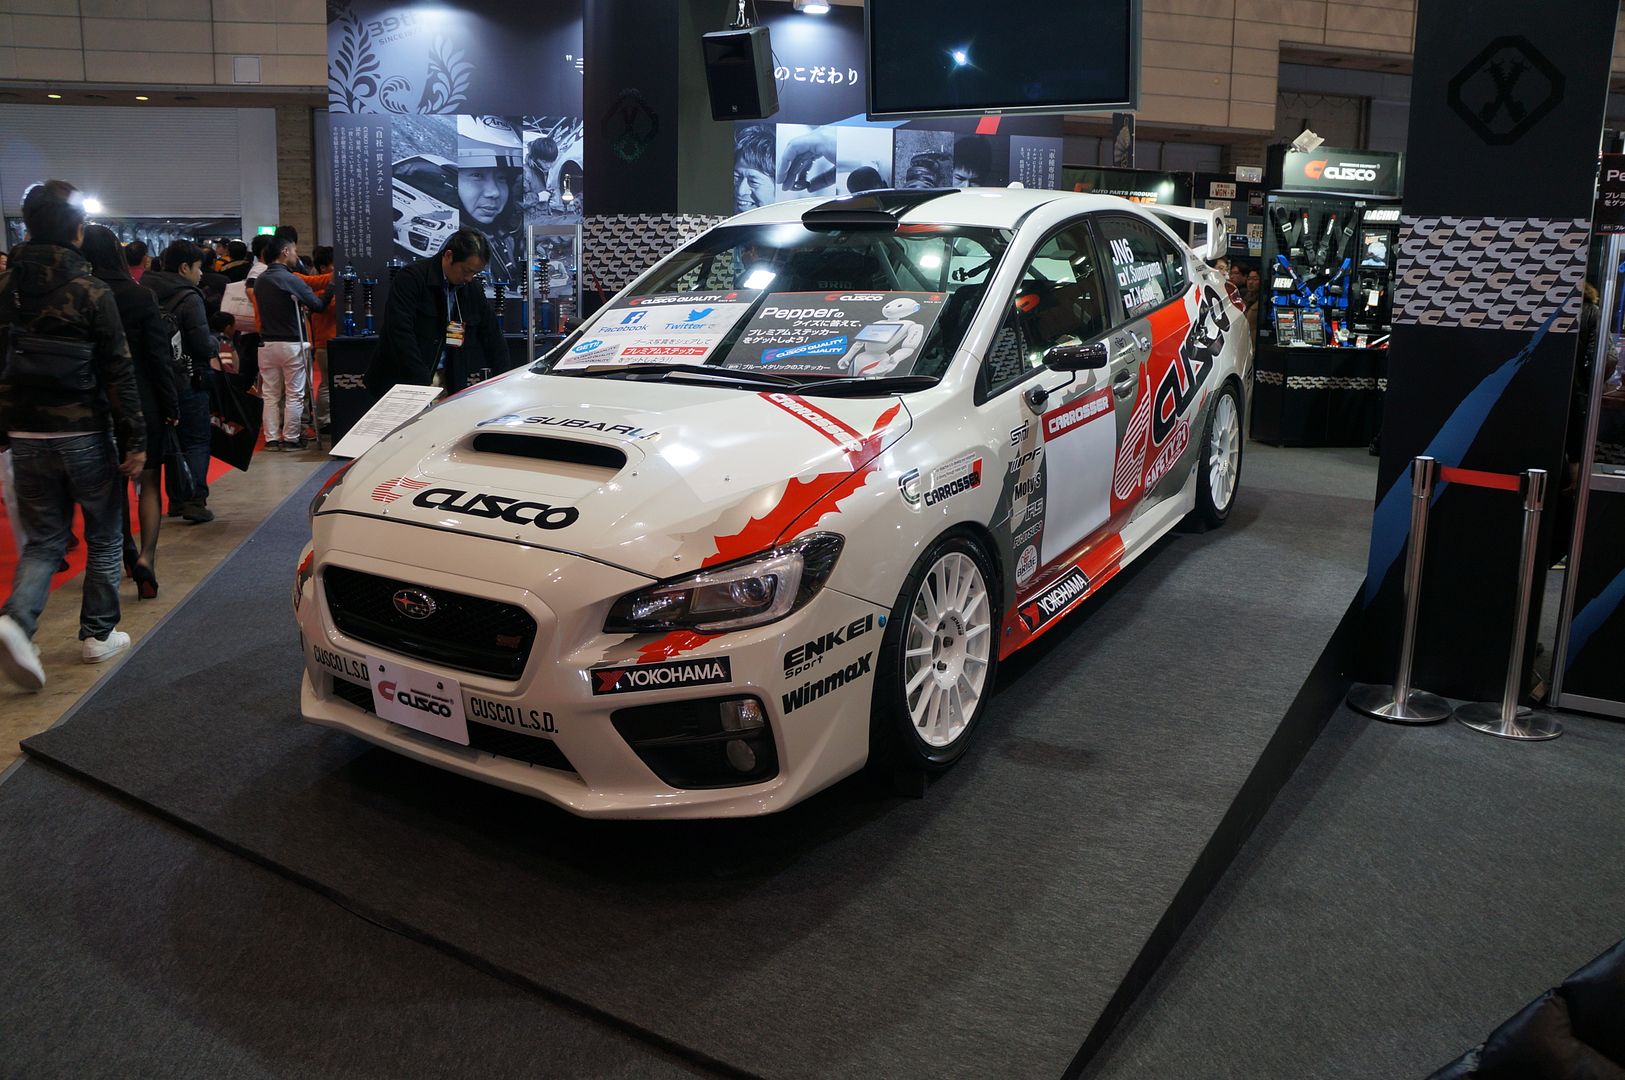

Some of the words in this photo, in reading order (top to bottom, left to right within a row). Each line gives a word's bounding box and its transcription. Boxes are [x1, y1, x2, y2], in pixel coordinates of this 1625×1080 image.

[1323, 166, 1377, 182] CUSCO
[1110, 238, 1134, 266] JN6
[1273, 277, 1294, 288] NEW
[641, 297, 677, 305] CUSCO
[677, 295, 722, 303] QUALITY
[598, 324, 649, 333] Facebook
[624, 347, 704, 355] プレミアムステッカー
[523, 416, 660, 440] SUBARU
[768, 393, 863, 451] CARROSSER
[1048, 396, 1109, 434] CARROSSER
[923, 471, 981, 507] CARROSSER
[412, 487, 579, 530] CUSCO
[1016, 556, 1037, 577] BRIDE
[1037, 573, 1087, 616] YOKOHAMA
[784, 613, 874, 671] ENKEI
[313, 645, 343, 673] CUSCO
[784, 655, 824, 680] Sport
[625, 662, 725, 687] YOKOHAMA
[397, 691, 452, 718] CUSCO
[470, 696, 515, 726] CUSCO
[518, 707, 559, 733] L.S.D.
